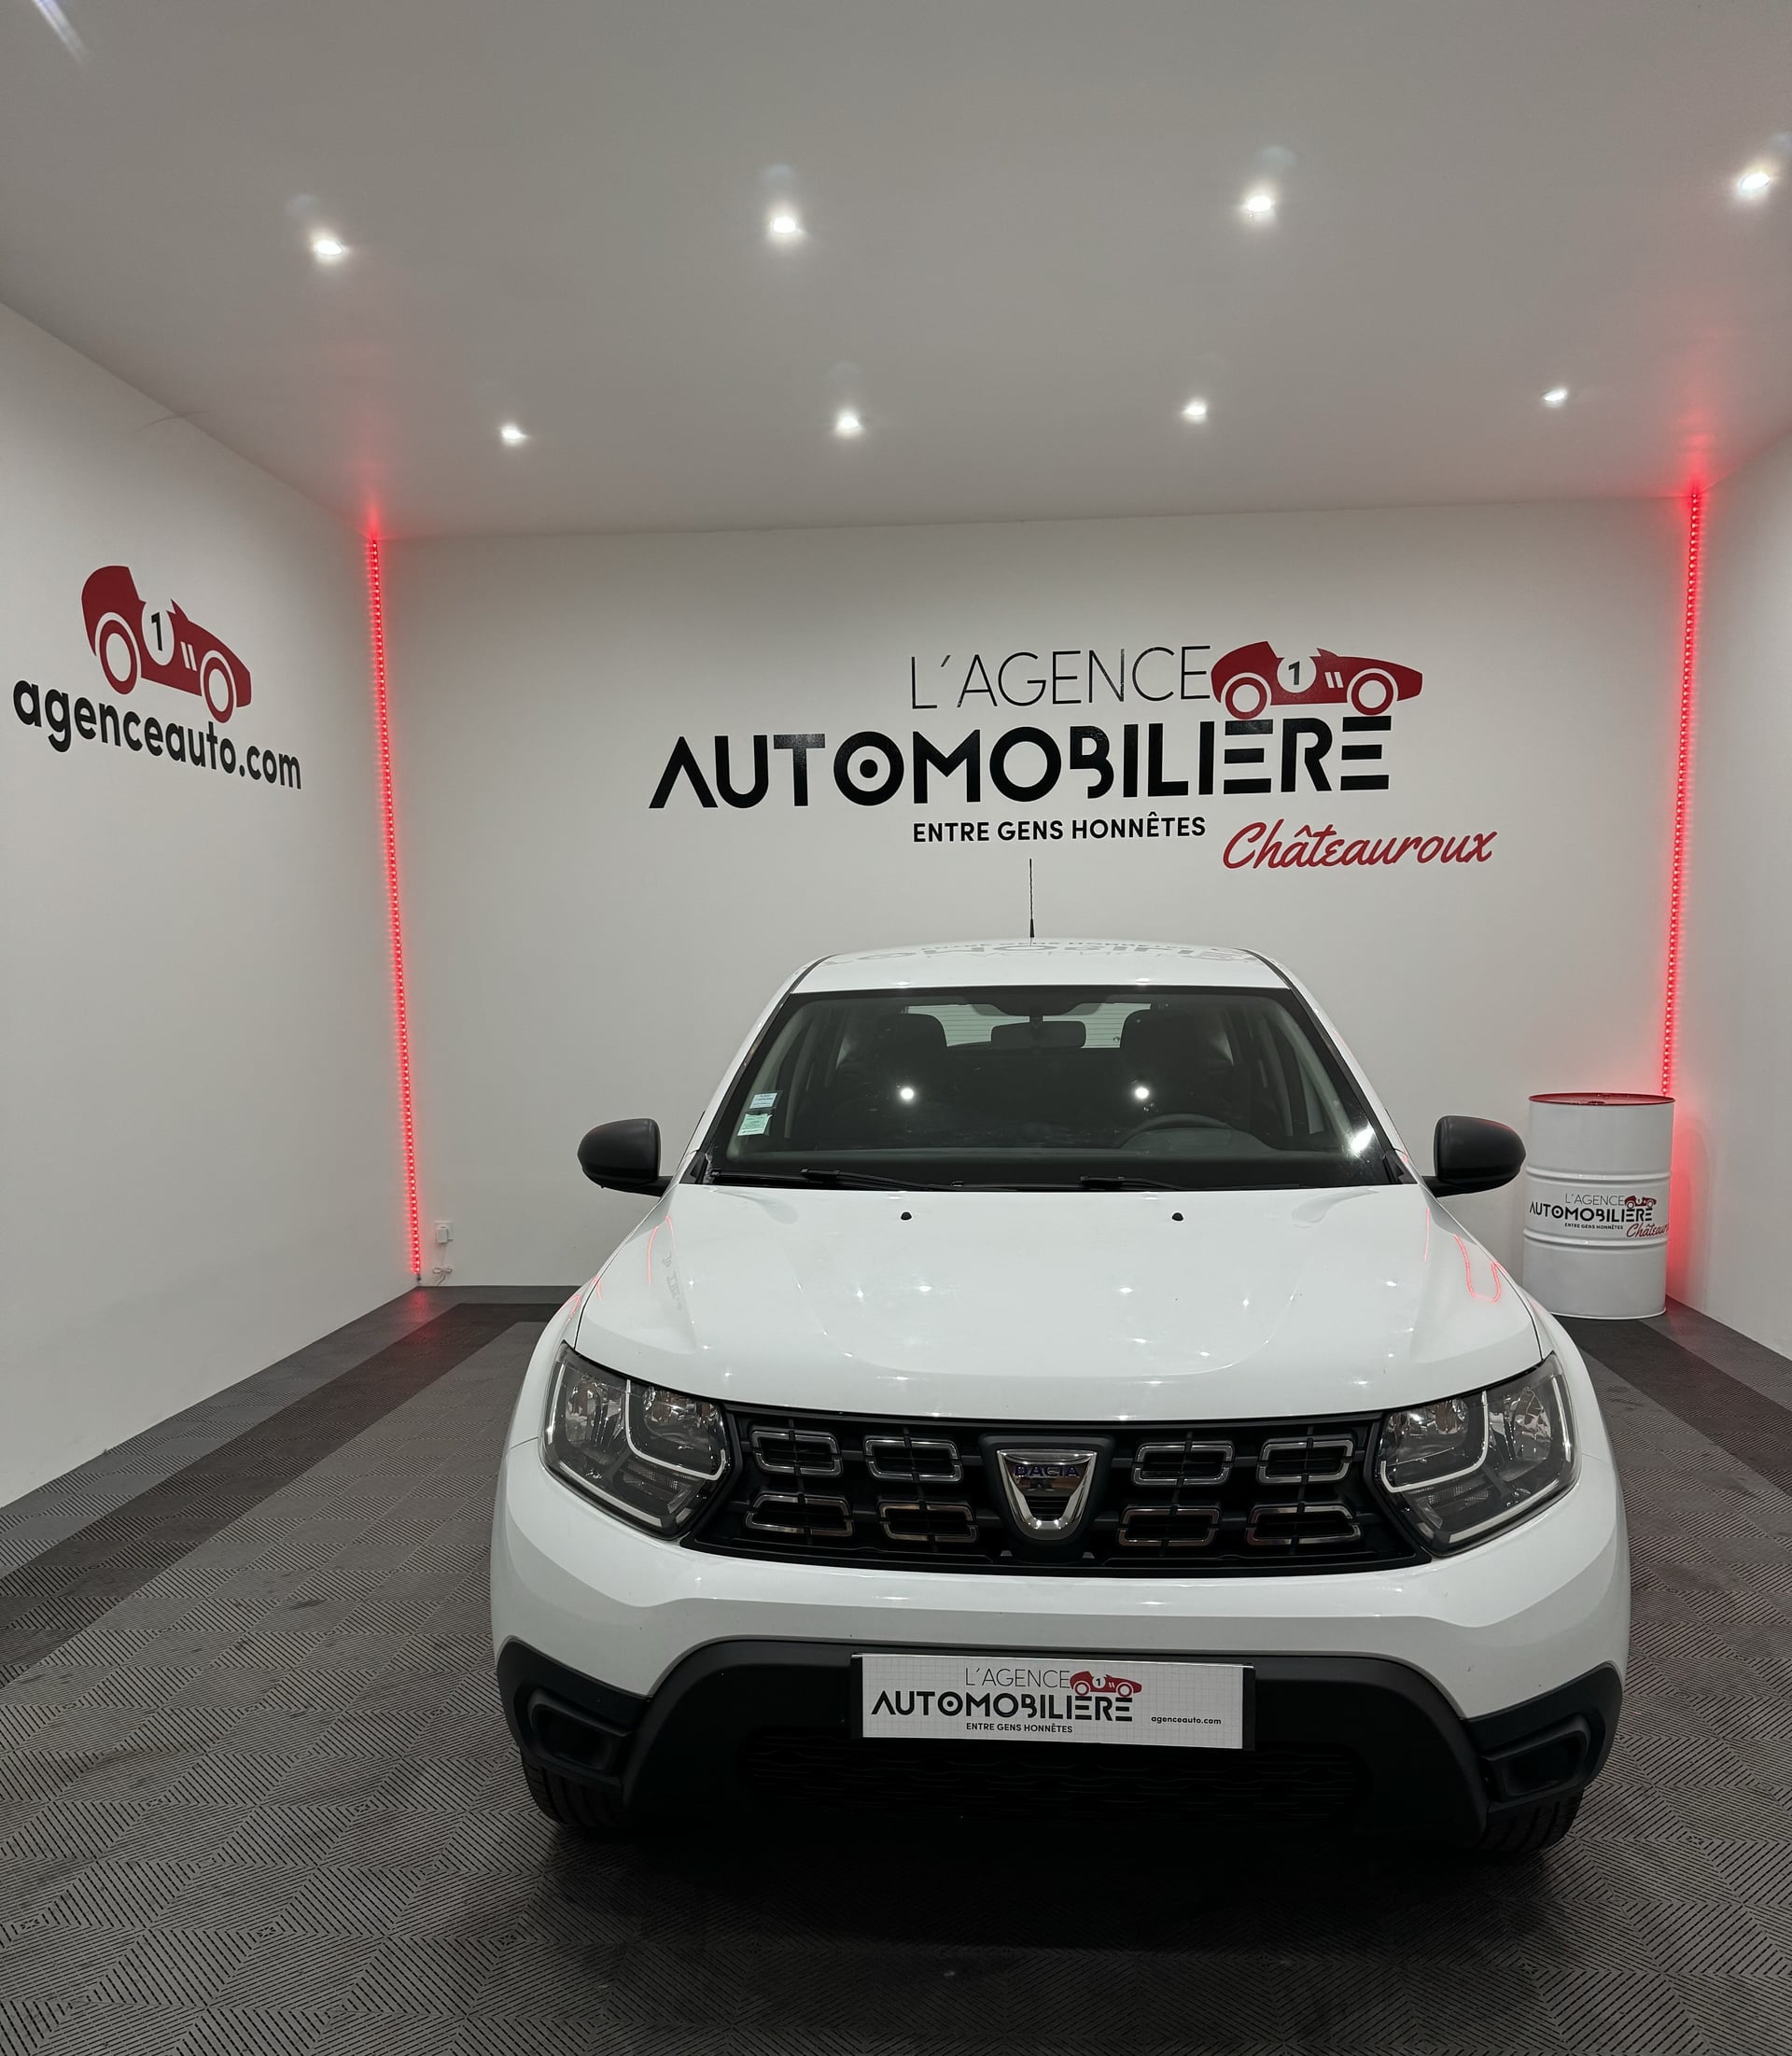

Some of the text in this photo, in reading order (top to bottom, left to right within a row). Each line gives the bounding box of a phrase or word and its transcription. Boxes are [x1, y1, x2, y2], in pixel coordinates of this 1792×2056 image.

[151, 611, 163, 651] 1
[911, 645, 1211, 709] L'AGENCE
[1288, 660, 1301, 685] 1
[12, 679, 302, 790] agenceauto.com
[913, 811, 1207, 842] ENTRE GENS HONNÊTES
[1223, 818, 1497, 869] Châteauroux
[1014, 1465, 1080, 1478] DACIA
[965, 1668, 1071, 1688] L'AGENCE
[966, 1722, 1073, 1733] ENTRE GENS HONNÊTES
[1151, 1715, 1222, 1725] agenceauto.com
